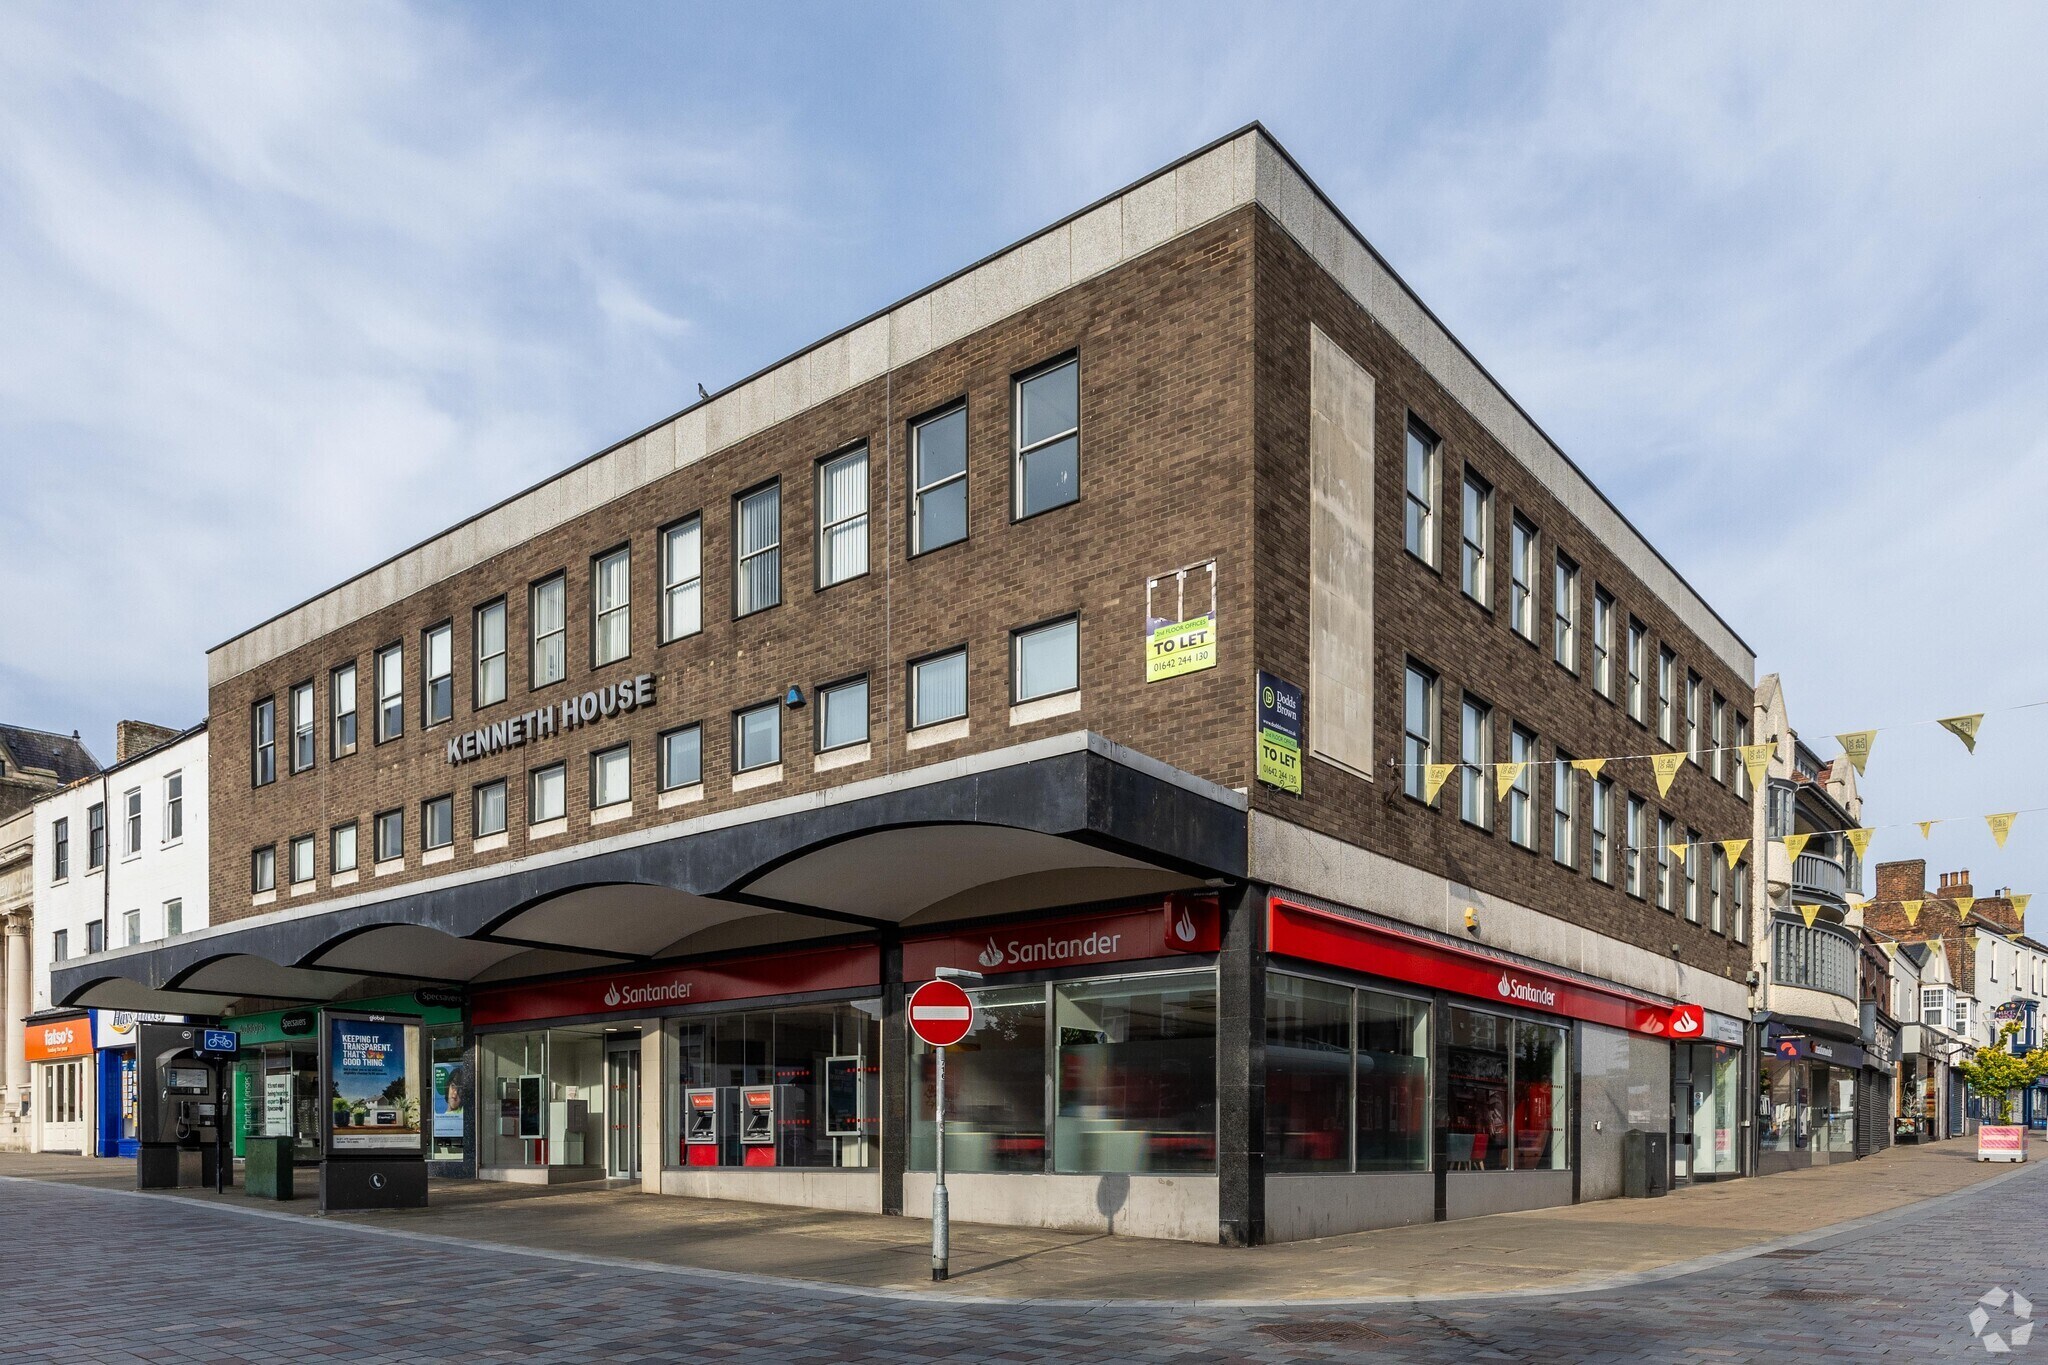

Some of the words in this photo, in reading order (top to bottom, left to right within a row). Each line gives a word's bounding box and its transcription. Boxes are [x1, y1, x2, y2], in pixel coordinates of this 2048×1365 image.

[1165, 624, 1184, 634] FLOOR
[1184, 618, 1207, 630] OFFICES
[1154, 639, 1175, 655] TO
[1180, 630, 1208, 649] LET
[1153, 658, 1176, 672] 01642
[1177, 654, 1192, 666] 244
[1195, 650, 1209, 662] 130
[1276, 691, 1296, 709] Dodds
[447, 705, 556, 766] KENNETH
[562, 672, 656, 731] HOUSE
[1276, 701, 1297, 721] Brown
[1263, 745, 1278, 762] TO
[1280, 751, 1297, 769] LET
[1262, 763, 1278, 779] 01642
[1278, 768, 1288, 780] 244
[1288, 773, 1297, 785] 130
[1007, 931, 1121, 964] Santander
[622, 979, 693, 1005] Santander
[1511, 978, 1556, 1007] Santander
[113, 1011, 133, 1026] Hays
[282, 1017, 306, 1029] Specsavers
[45, 1027, 74, 1046] fatso's
[342, 1034, 371, 1044] KEEPING
[372, 1036, 380, 1044] IT
[342, 1042, 393, 1052] TRANSPARENT.
[342, 1050, 366, 1058] THAT'S
[342, 1058, 362, 1066] GOOD
[363, 1059, 385, 1067] THING.
[243, 1076, 252, 1100] Lenses
[243, 1101, 252, 1130] Contact
